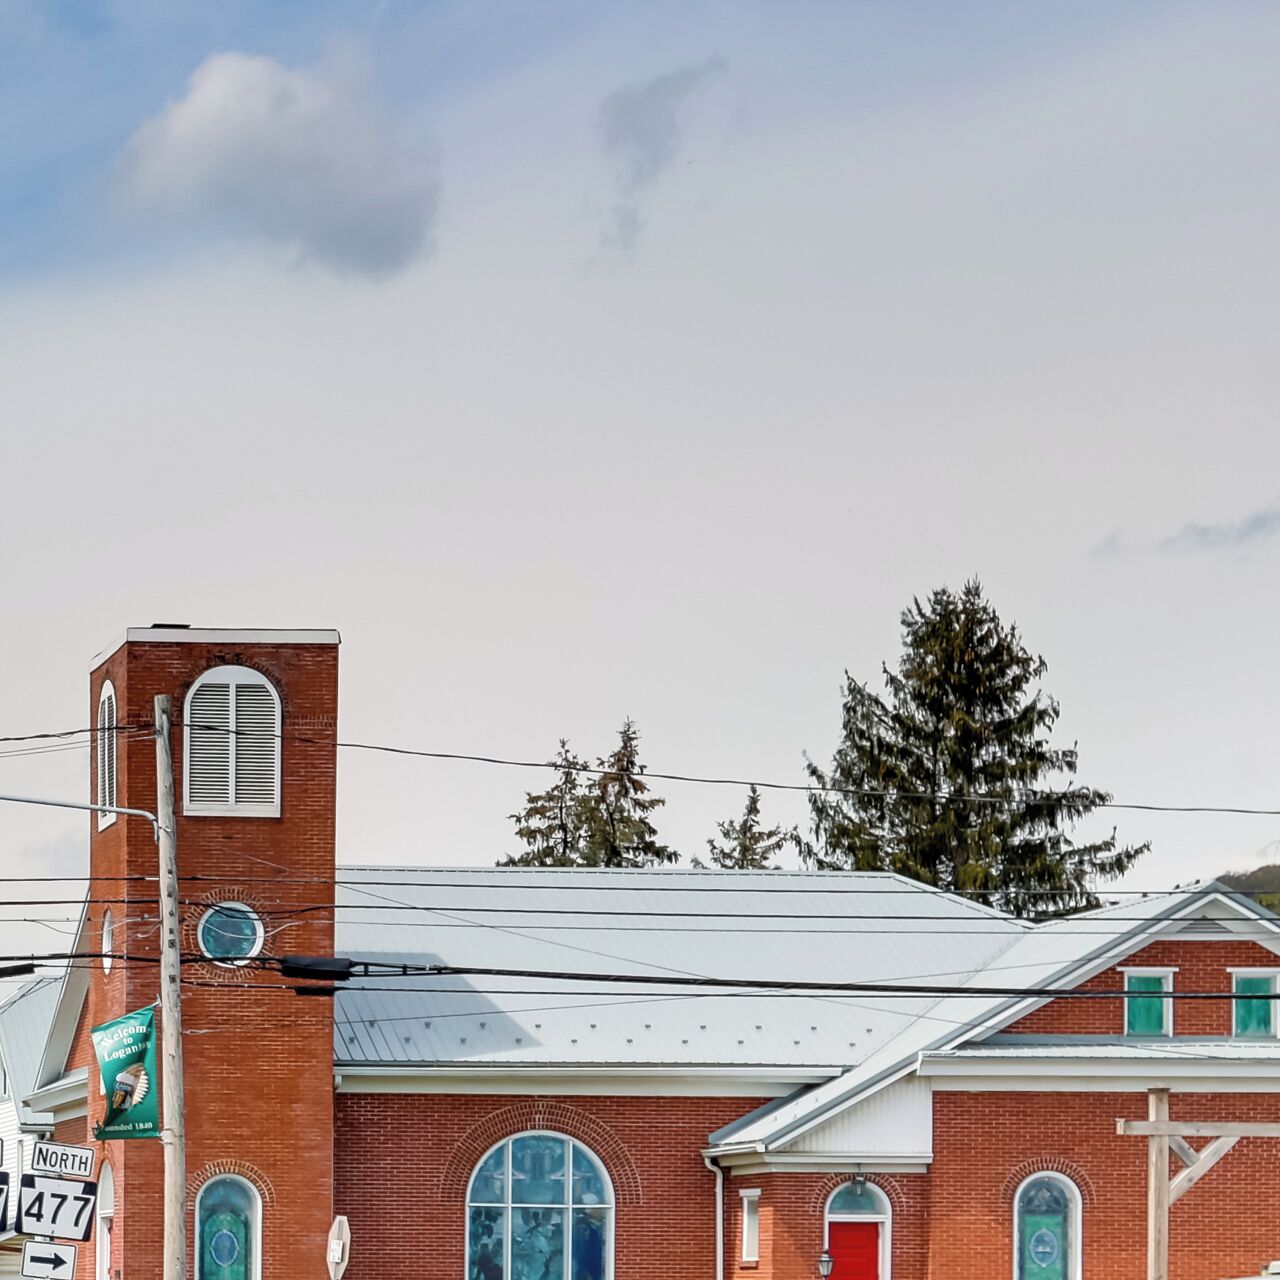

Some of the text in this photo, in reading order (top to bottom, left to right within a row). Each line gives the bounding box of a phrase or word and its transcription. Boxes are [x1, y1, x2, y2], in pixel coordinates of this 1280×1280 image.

[124, 1036, 133, 1045] to
[37, 1147, 88, 1172] NORTH
[24, 1191, 90, 1228] 477
